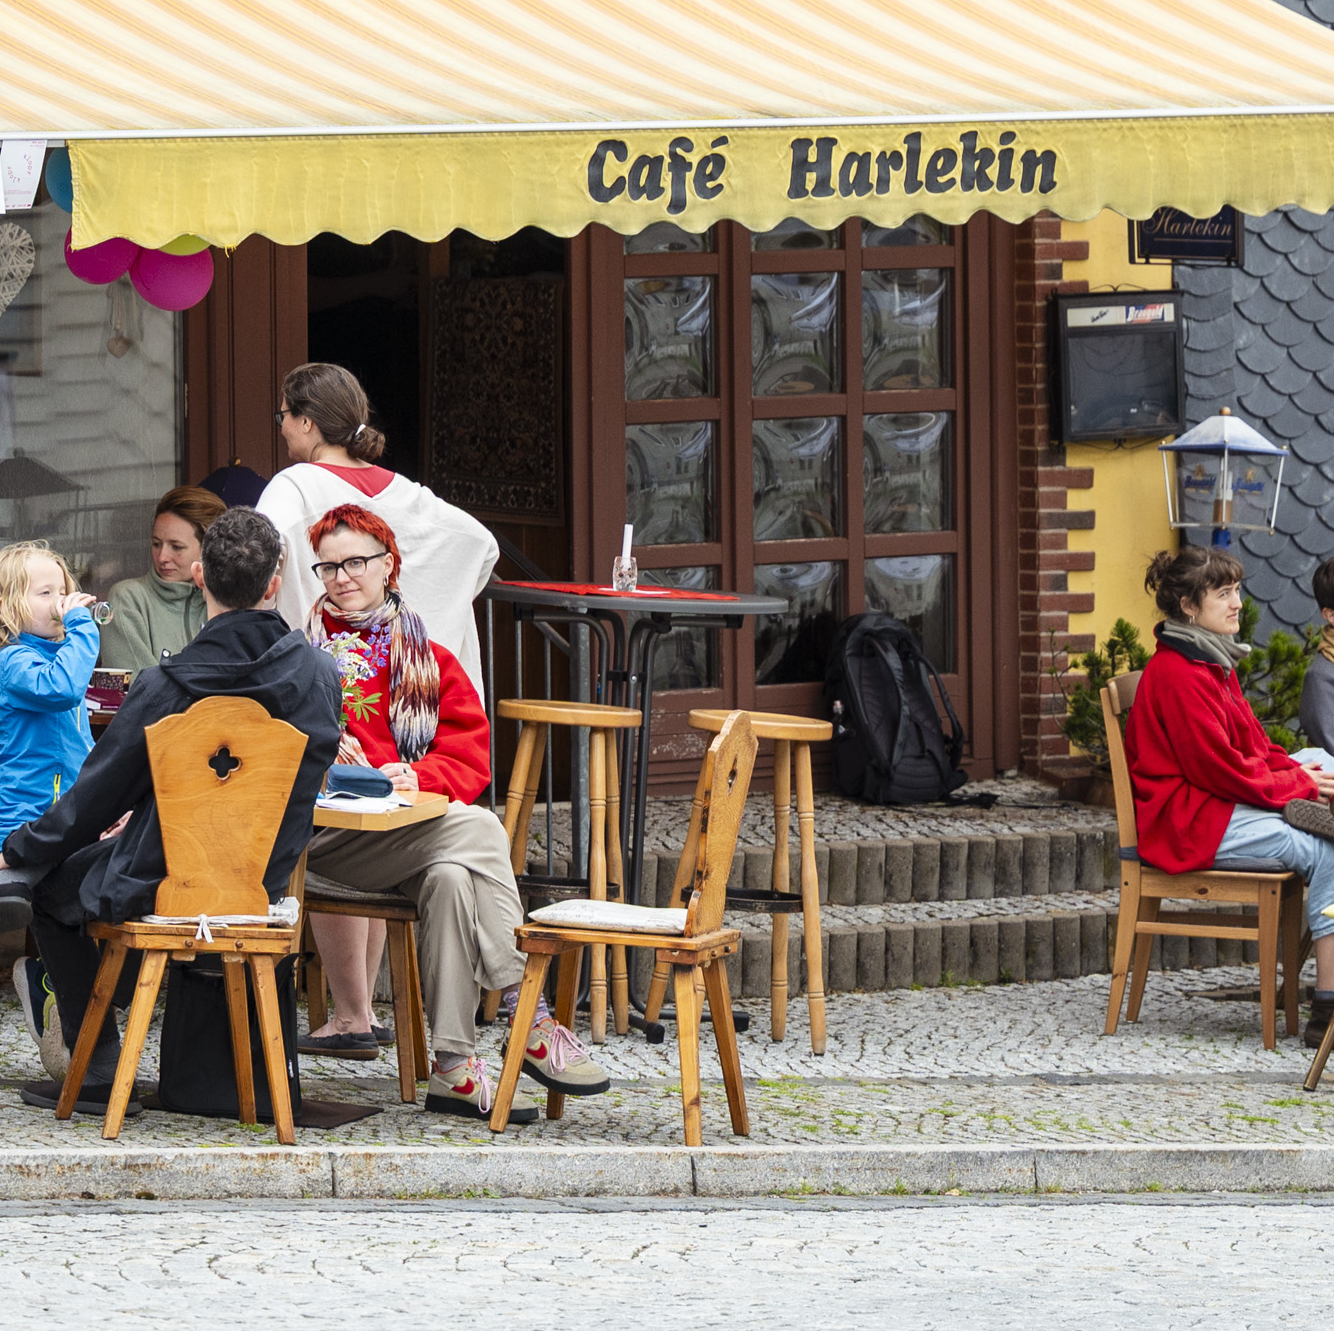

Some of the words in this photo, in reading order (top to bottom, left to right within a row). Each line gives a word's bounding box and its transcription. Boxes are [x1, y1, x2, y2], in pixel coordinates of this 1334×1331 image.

[587, 135, 730, 215] Café
[787, 130, 1058, 200] Harlekin
[1141, 207, 1232, 236] Harlekin
